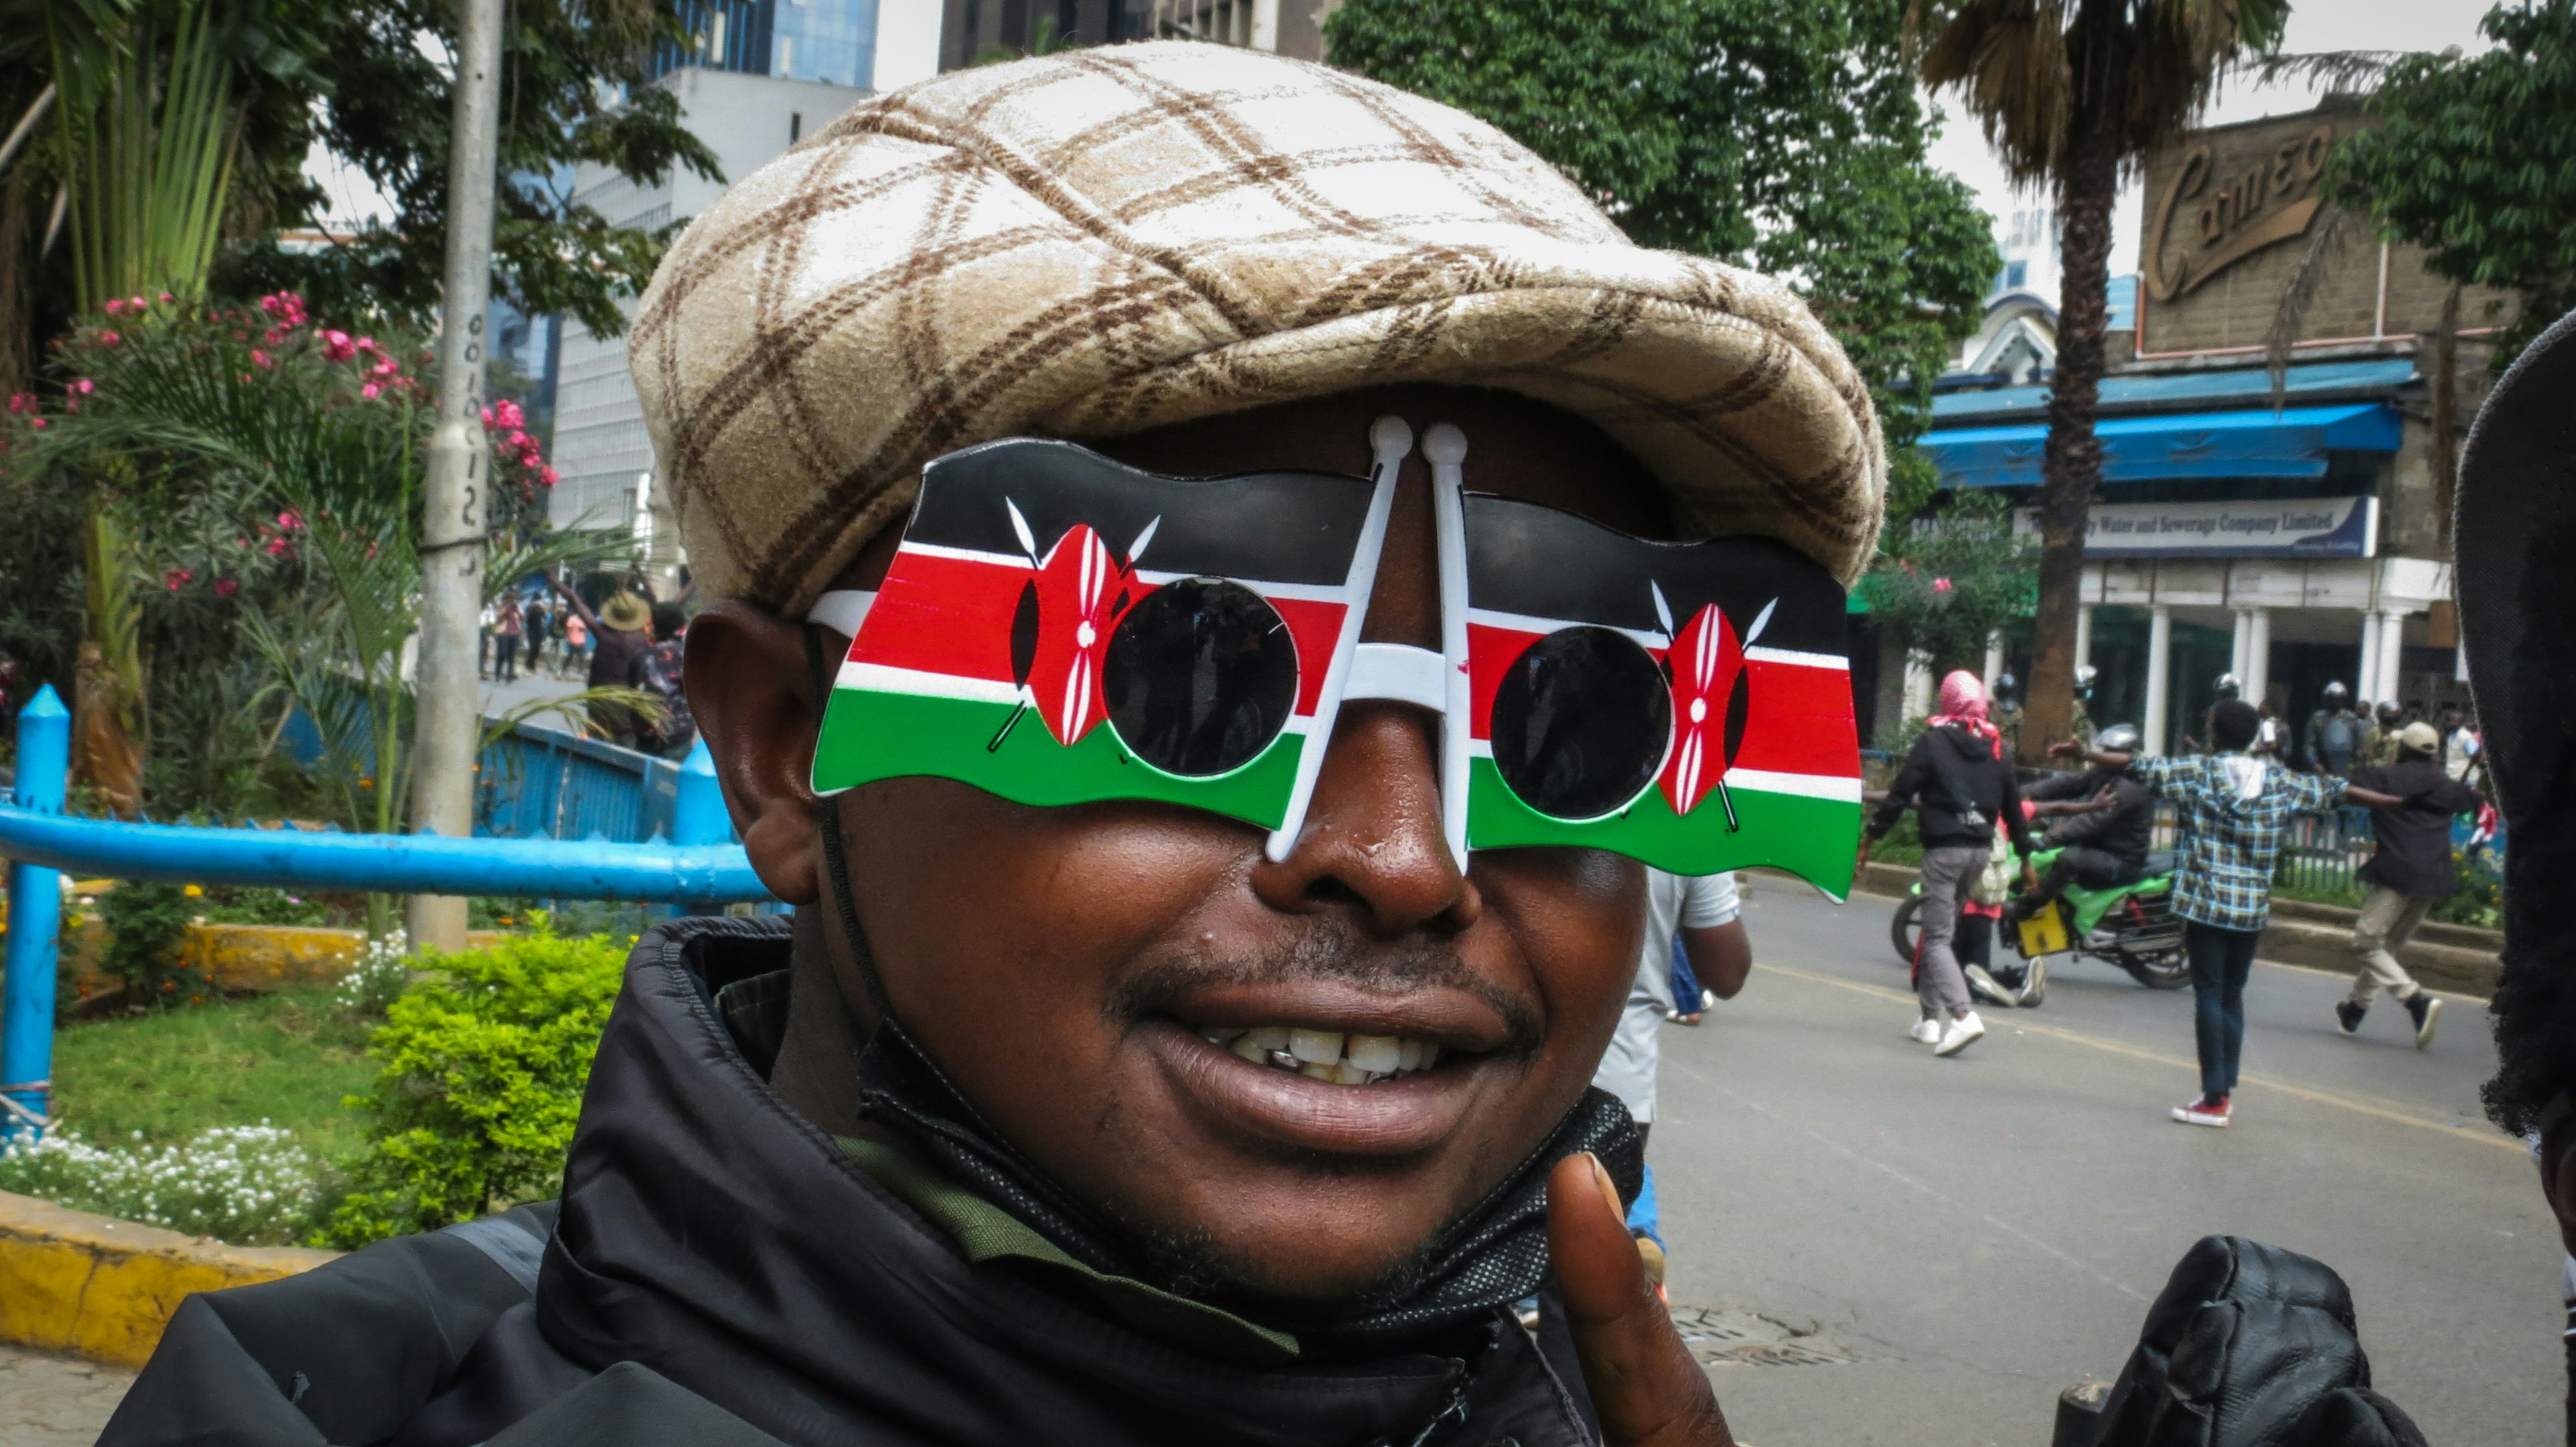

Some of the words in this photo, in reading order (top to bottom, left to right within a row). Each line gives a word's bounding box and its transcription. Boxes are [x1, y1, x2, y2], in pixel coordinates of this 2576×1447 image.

[2101, 515, 2133, 533] Water
[2135, 515, 2157, 533] and
[2160, 515, 2217, 537] Sewerage
[2219, 513, 2278, 536] Company
[2282, 511, 2334, 531] Limited
